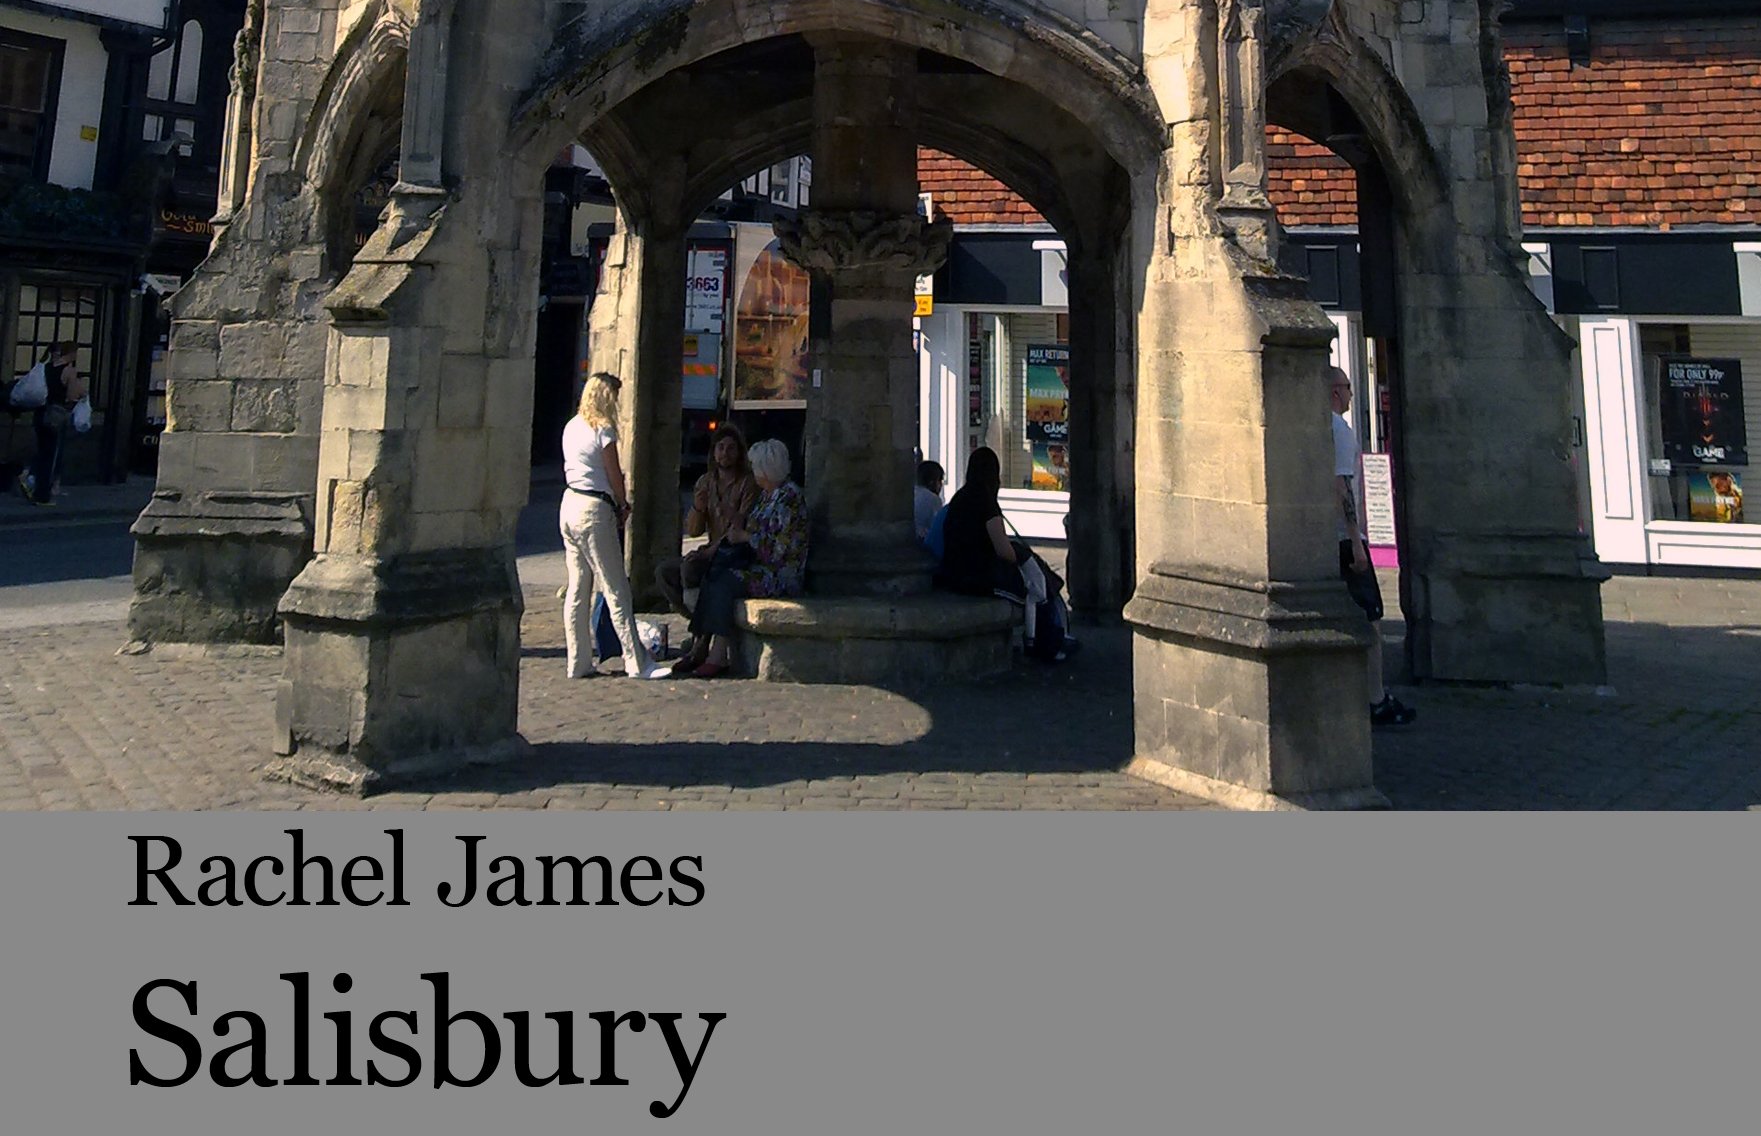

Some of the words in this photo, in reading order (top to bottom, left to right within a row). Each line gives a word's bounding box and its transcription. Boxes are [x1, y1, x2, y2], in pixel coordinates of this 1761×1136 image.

[686, 276, 719, 292] 3663
[1668, 368, 1685, 379] FOR
[1686, 369, 1707, 380] ONLY
[1043, 424, 1068, 434] GAME
[1693, 445, 1726, 459] GAME
